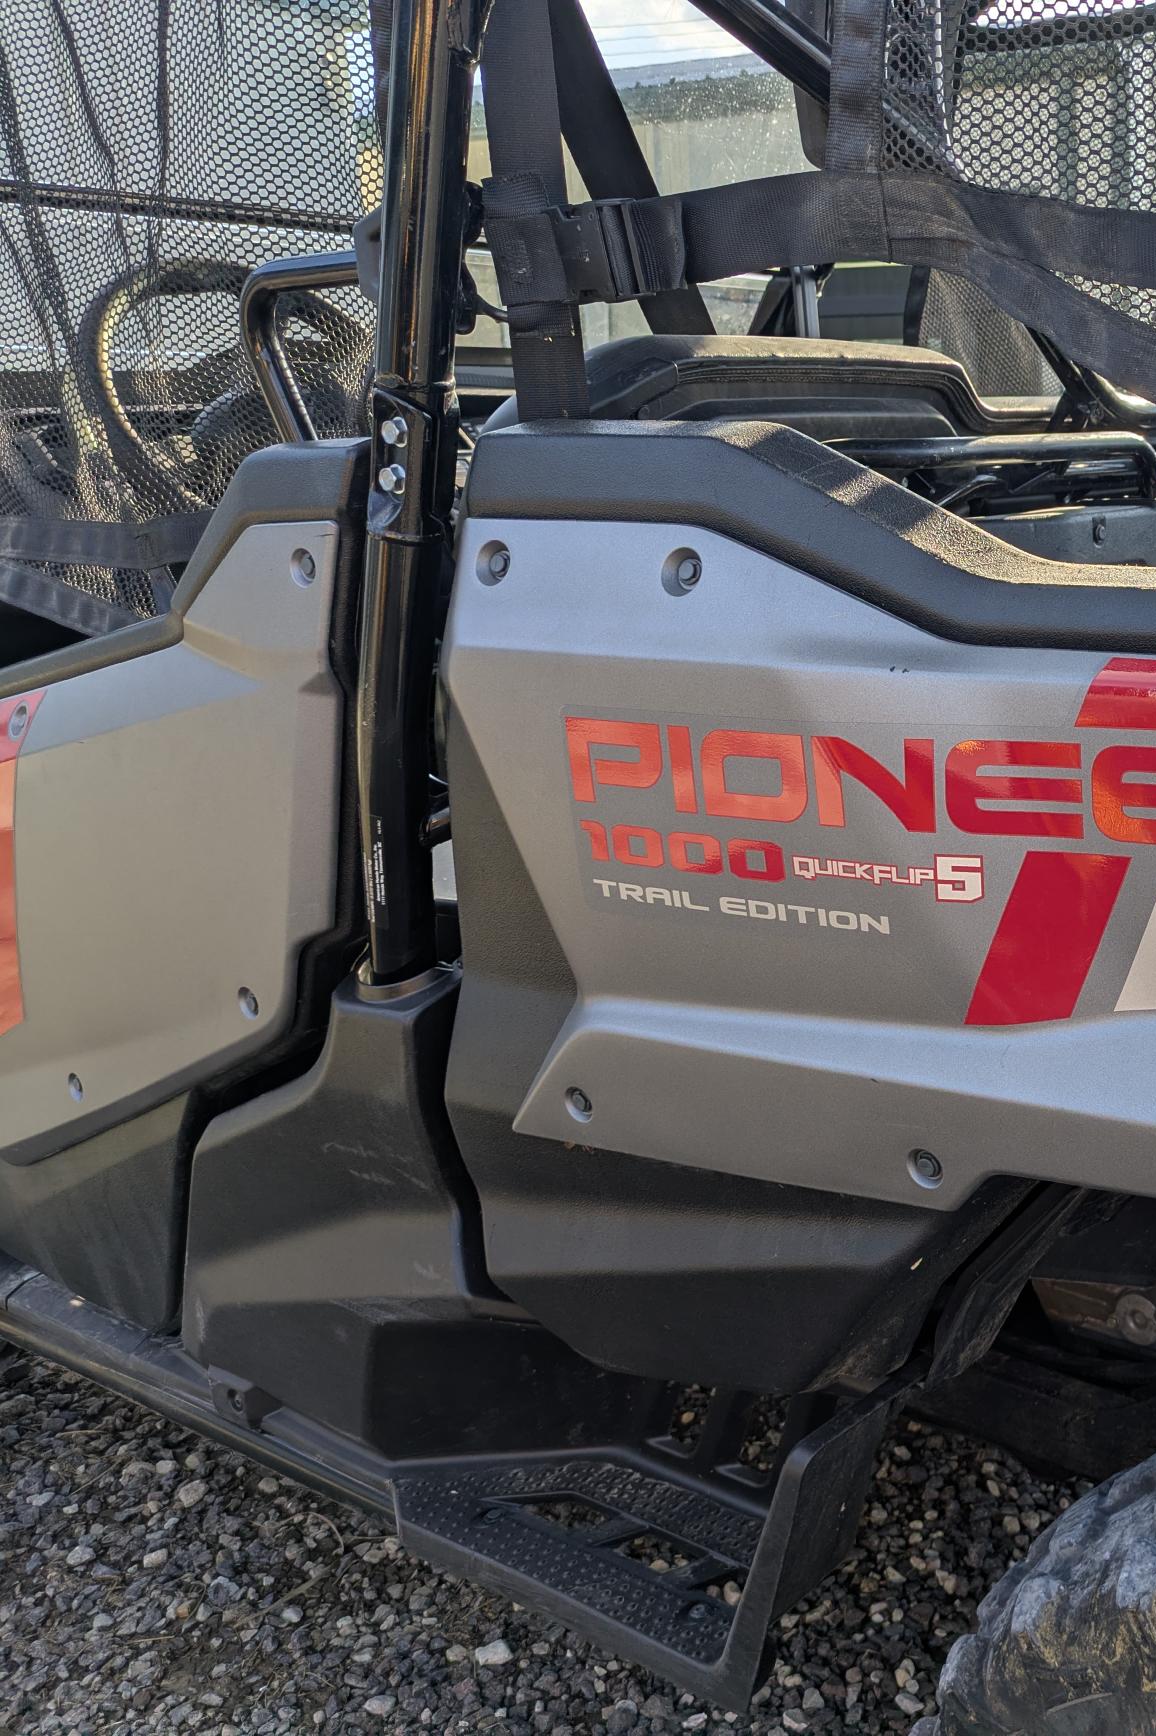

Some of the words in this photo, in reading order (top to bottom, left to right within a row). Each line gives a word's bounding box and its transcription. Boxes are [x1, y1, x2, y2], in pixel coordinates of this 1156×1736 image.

[580, 820, 785, 882] 1000
[593, 879, 709, 912] TRAIL
[720, 896, 890, 934] EDITION
